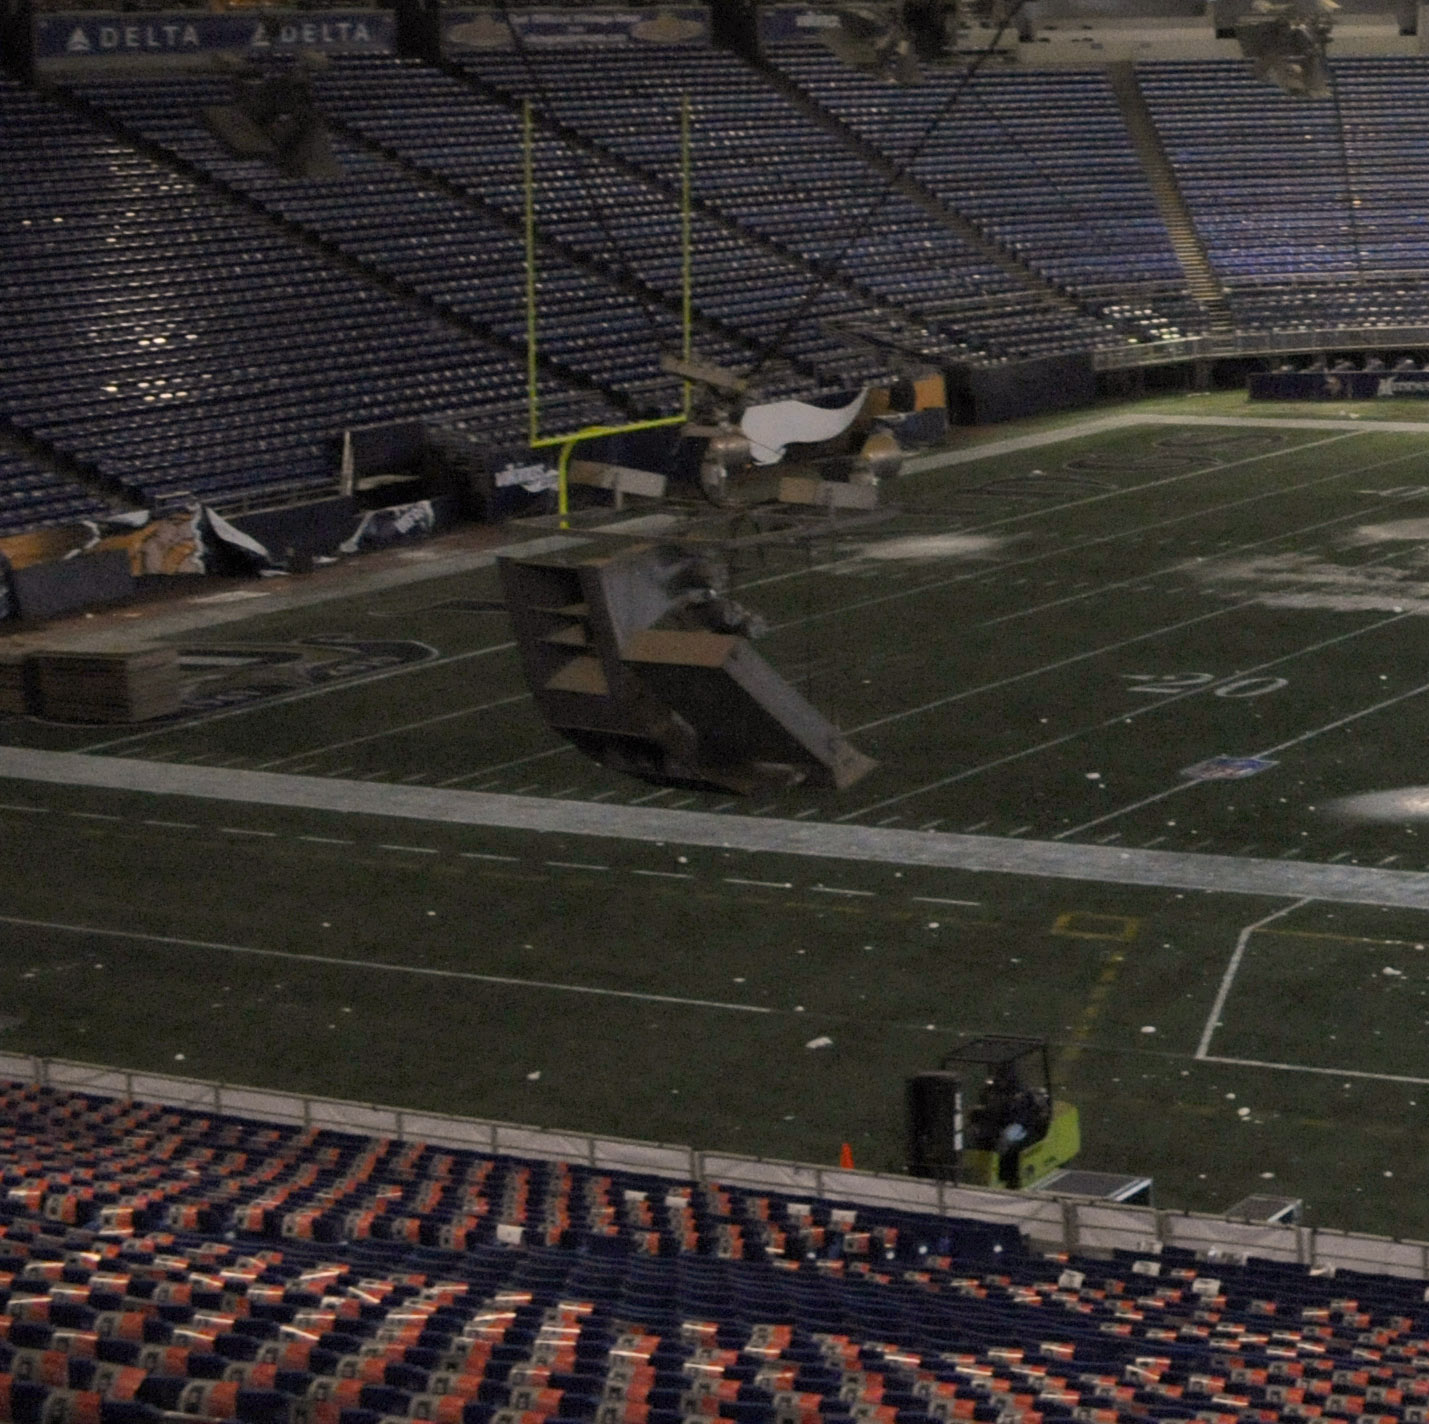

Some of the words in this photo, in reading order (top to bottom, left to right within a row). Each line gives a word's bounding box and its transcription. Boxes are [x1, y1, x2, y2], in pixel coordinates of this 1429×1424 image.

[100, 25, 200, 49] DELTA
[281, 22, 372, 43] DELTA
[1128, 672, 1289, 698] 20
